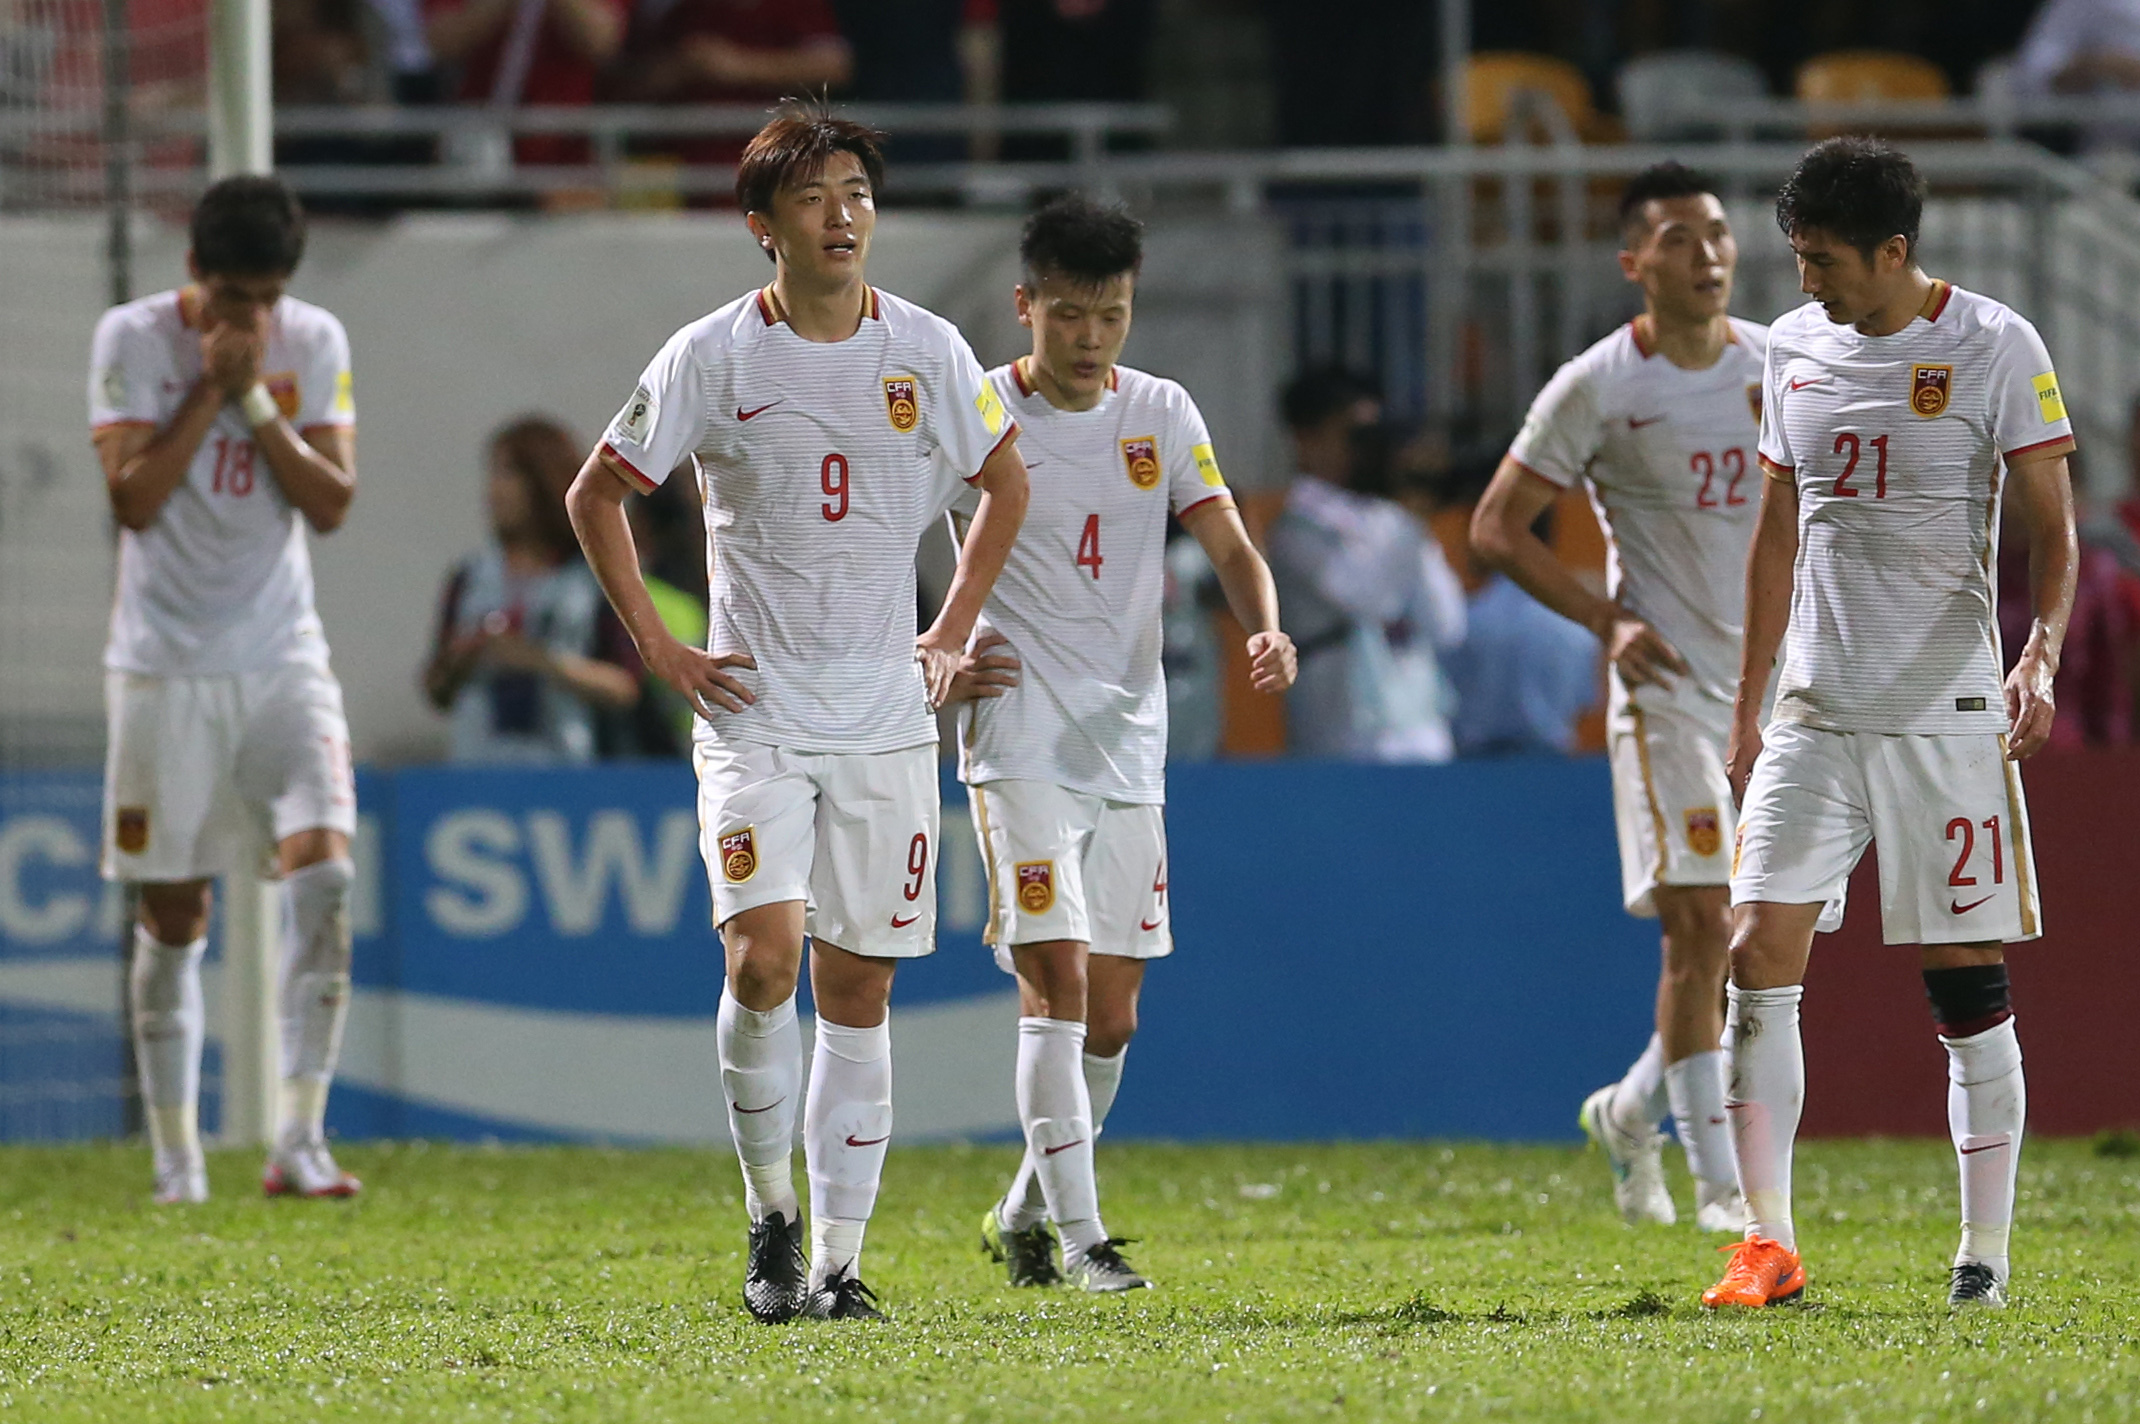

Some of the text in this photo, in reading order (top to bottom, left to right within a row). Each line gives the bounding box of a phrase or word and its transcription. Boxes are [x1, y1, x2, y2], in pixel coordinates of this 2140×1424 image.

[886, 381, 912, 393] CFA
[1918, 369, 1948, 379] CFA
[213, 436, 255, 498] 18
[821, 453, 849, 522] 9
[1689, 447, 1748, 507] 22
[1834, 433, 1889, 499] 21
[1077, 514, 1103, 580] 4
[722, 832, 751, 850] CFA
[904, 832, 928, 902] 9
[1946, 815, 2003, 887] 21
